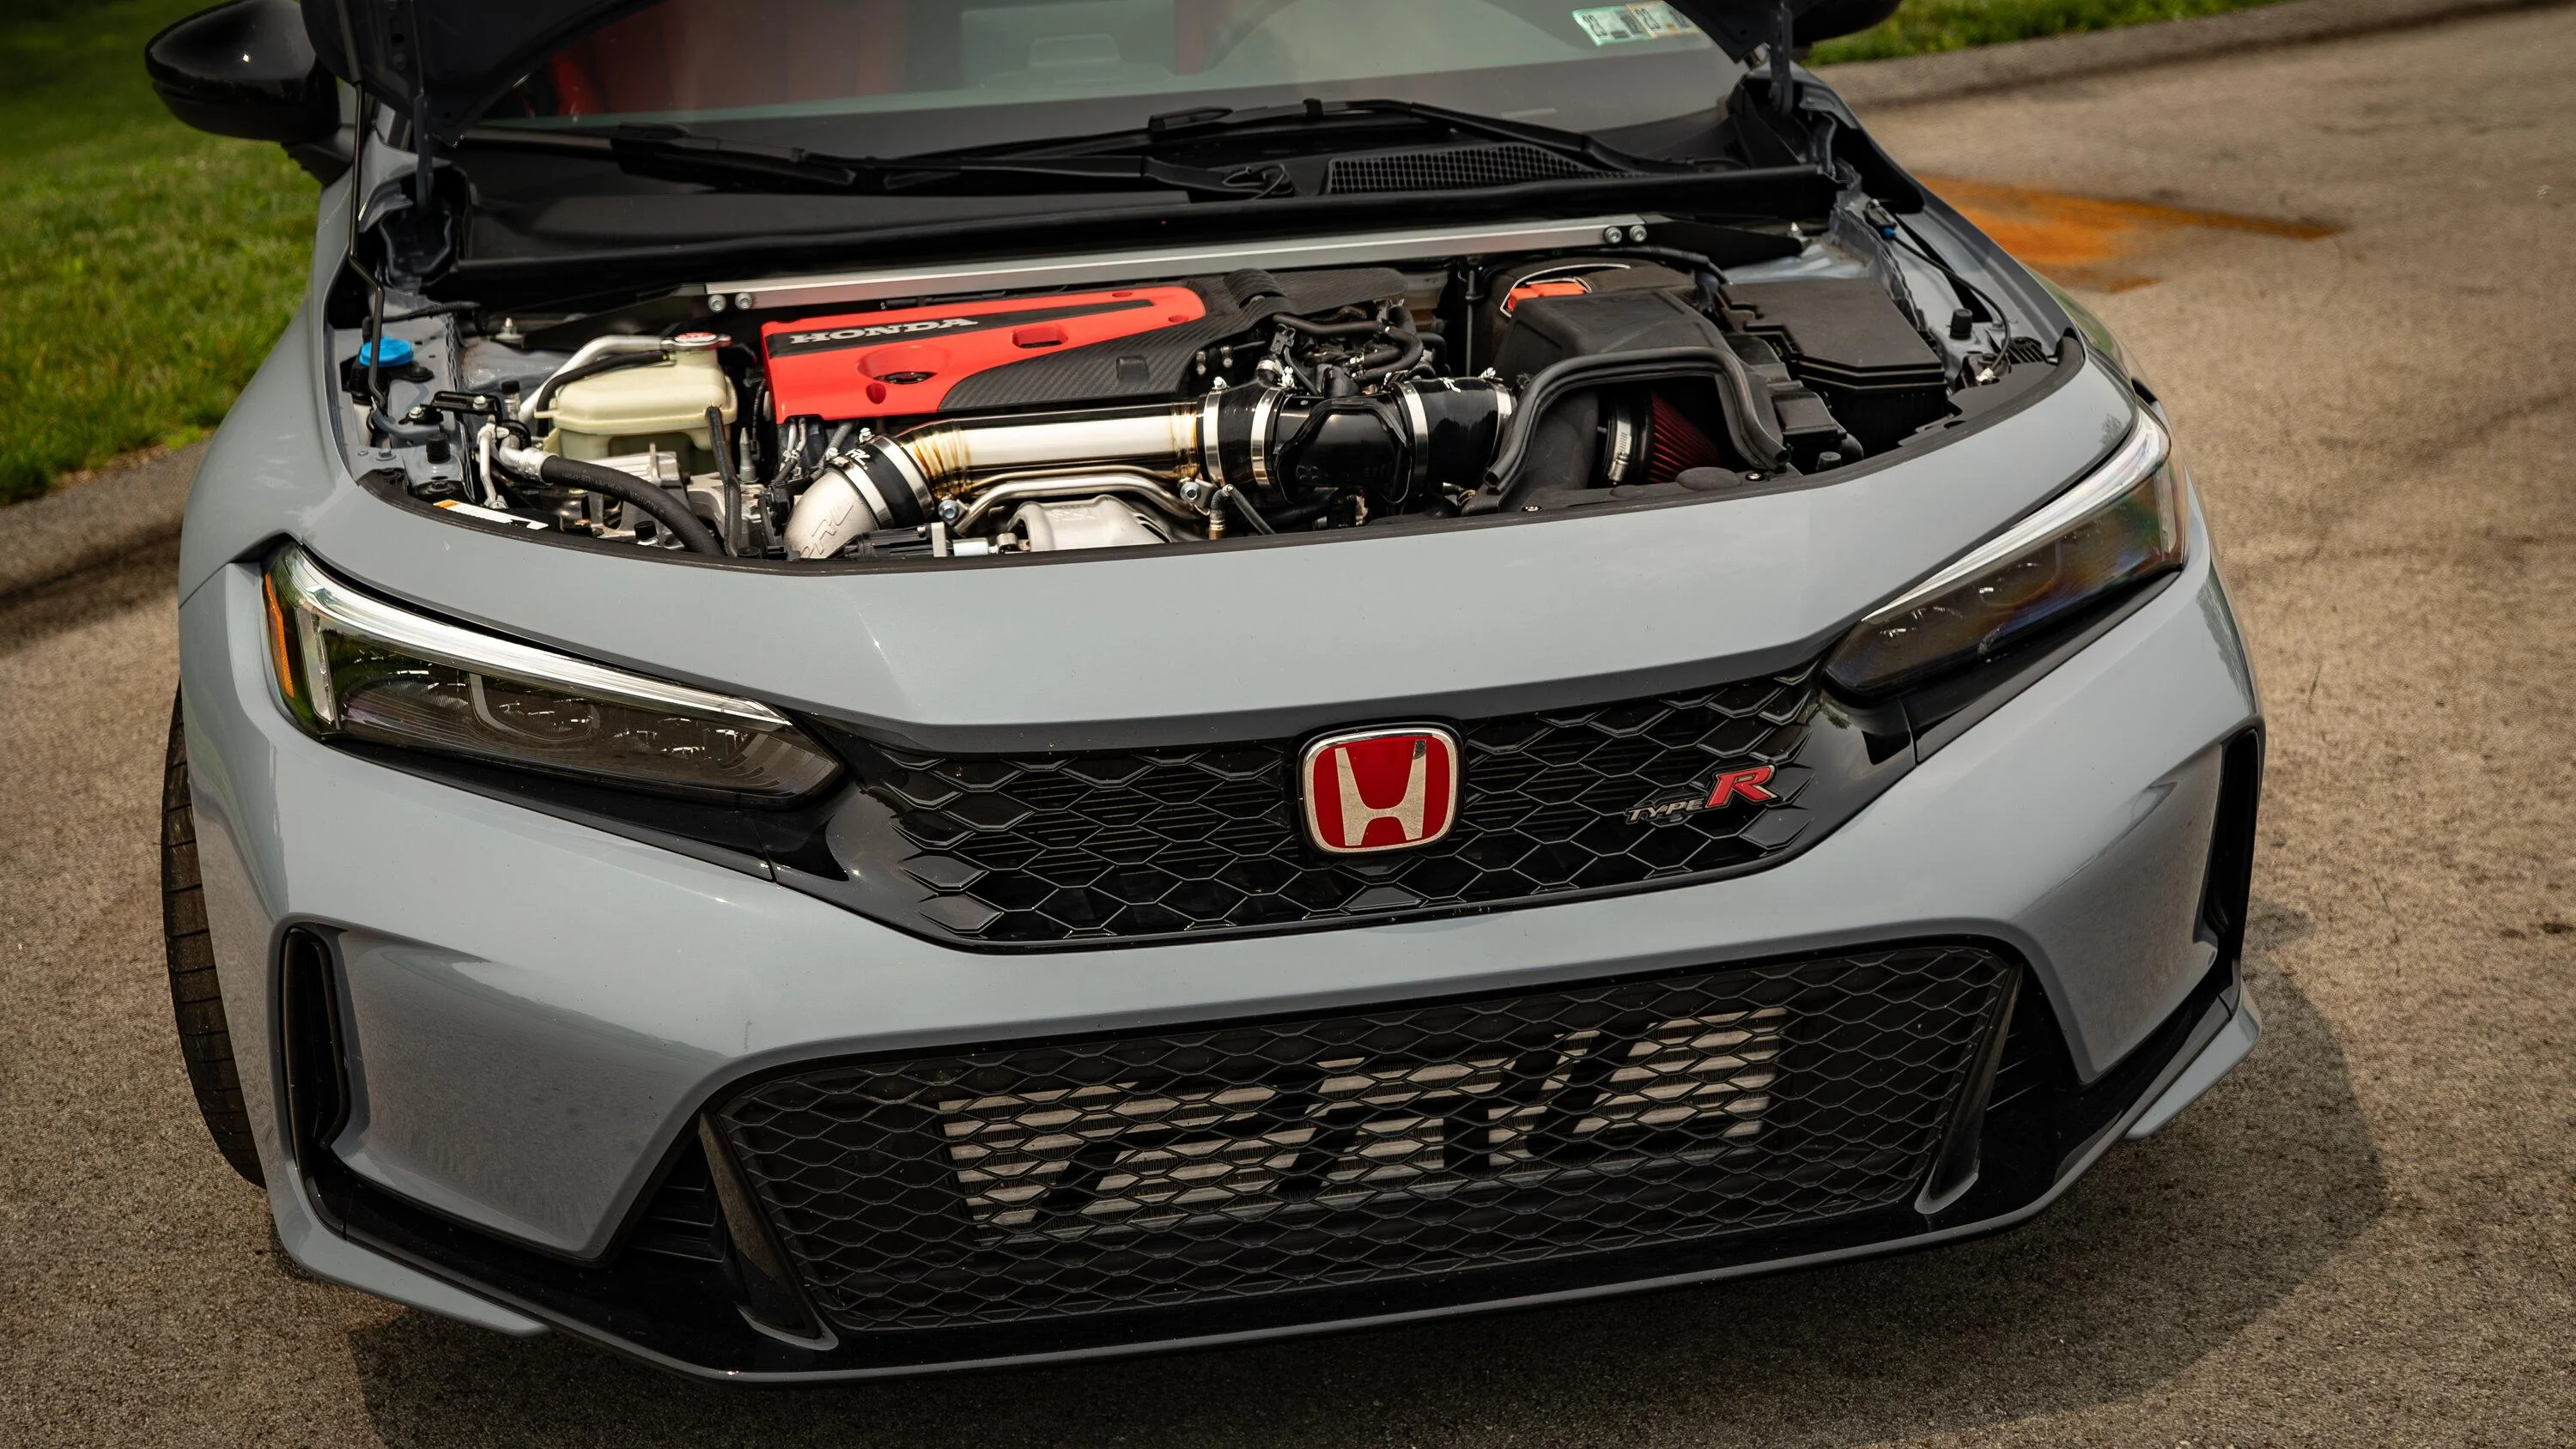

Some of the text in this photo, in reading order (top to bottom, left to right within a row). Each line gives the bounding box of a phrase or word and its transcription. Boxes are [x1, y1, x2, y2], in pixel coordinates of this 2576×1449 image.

[790, 318, 979, 344] HONDA
[1627, 764, 1780, 823] TYPE R
